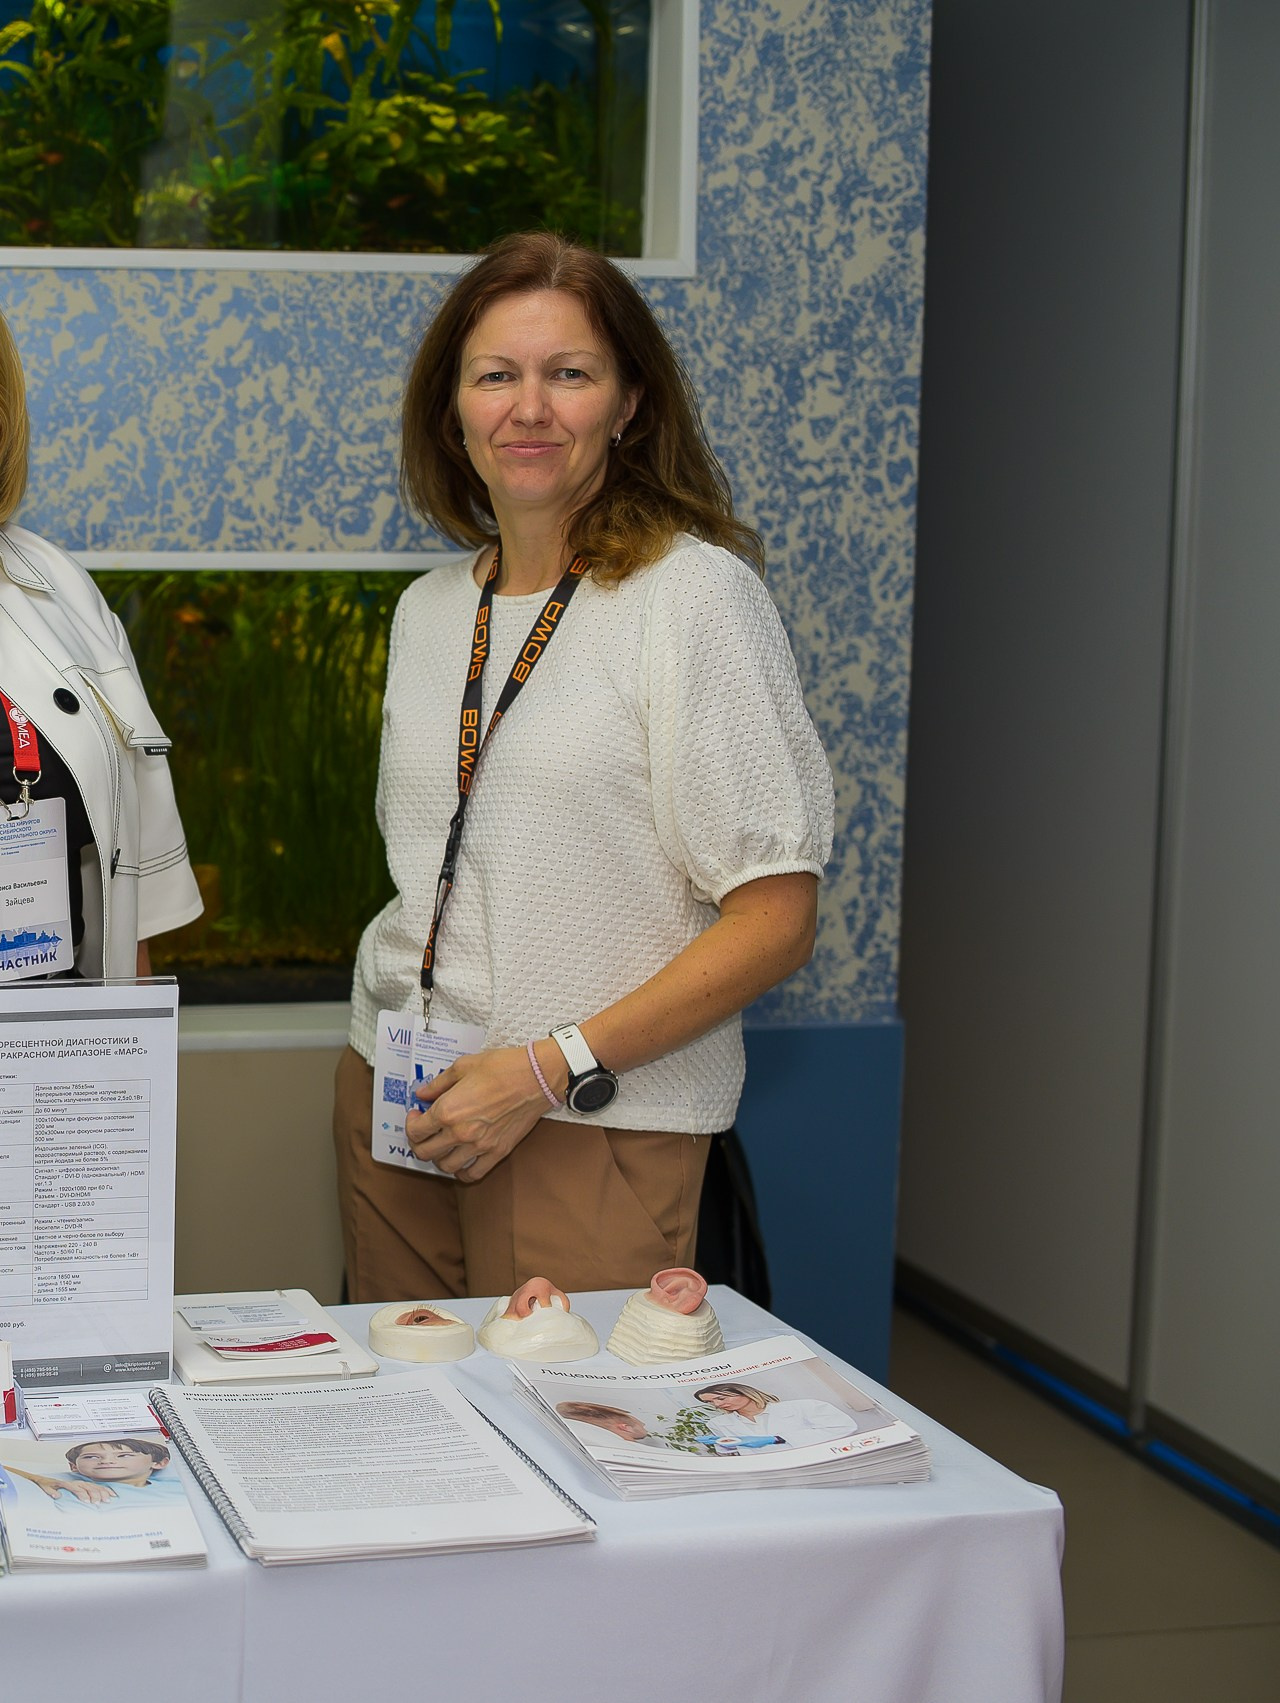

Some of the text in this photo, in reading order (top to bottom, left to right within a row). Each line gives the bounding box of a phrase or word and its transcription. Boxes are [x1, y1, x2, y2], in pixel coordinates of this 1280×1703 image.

[468, 605, 489, 681] BOWA
[512, 601, 564, 683] BOWA
[13, 879, 48, 890] Васильевна
[5, 896, 35, 907] Зайцева
[387, 1026, 411, 1046] VIII
[66, 1037, 130, 1047] ДИАГНОСТИКИ
[57, 1048, 111, 1058] ДИАПАЗОНЕ
[114, 1047, 148, 1056] «МАРС»
[35, 1151, 83, 1159] водорастворимый
[12, 1321, 26, 1329] руб.
[541, 1363, 732, 1381] Лицевые эктопротезы
[677, 1355, 793, 1384] НОВОЕ ОЩУЩЕНИЕ ЖИЗНИ
